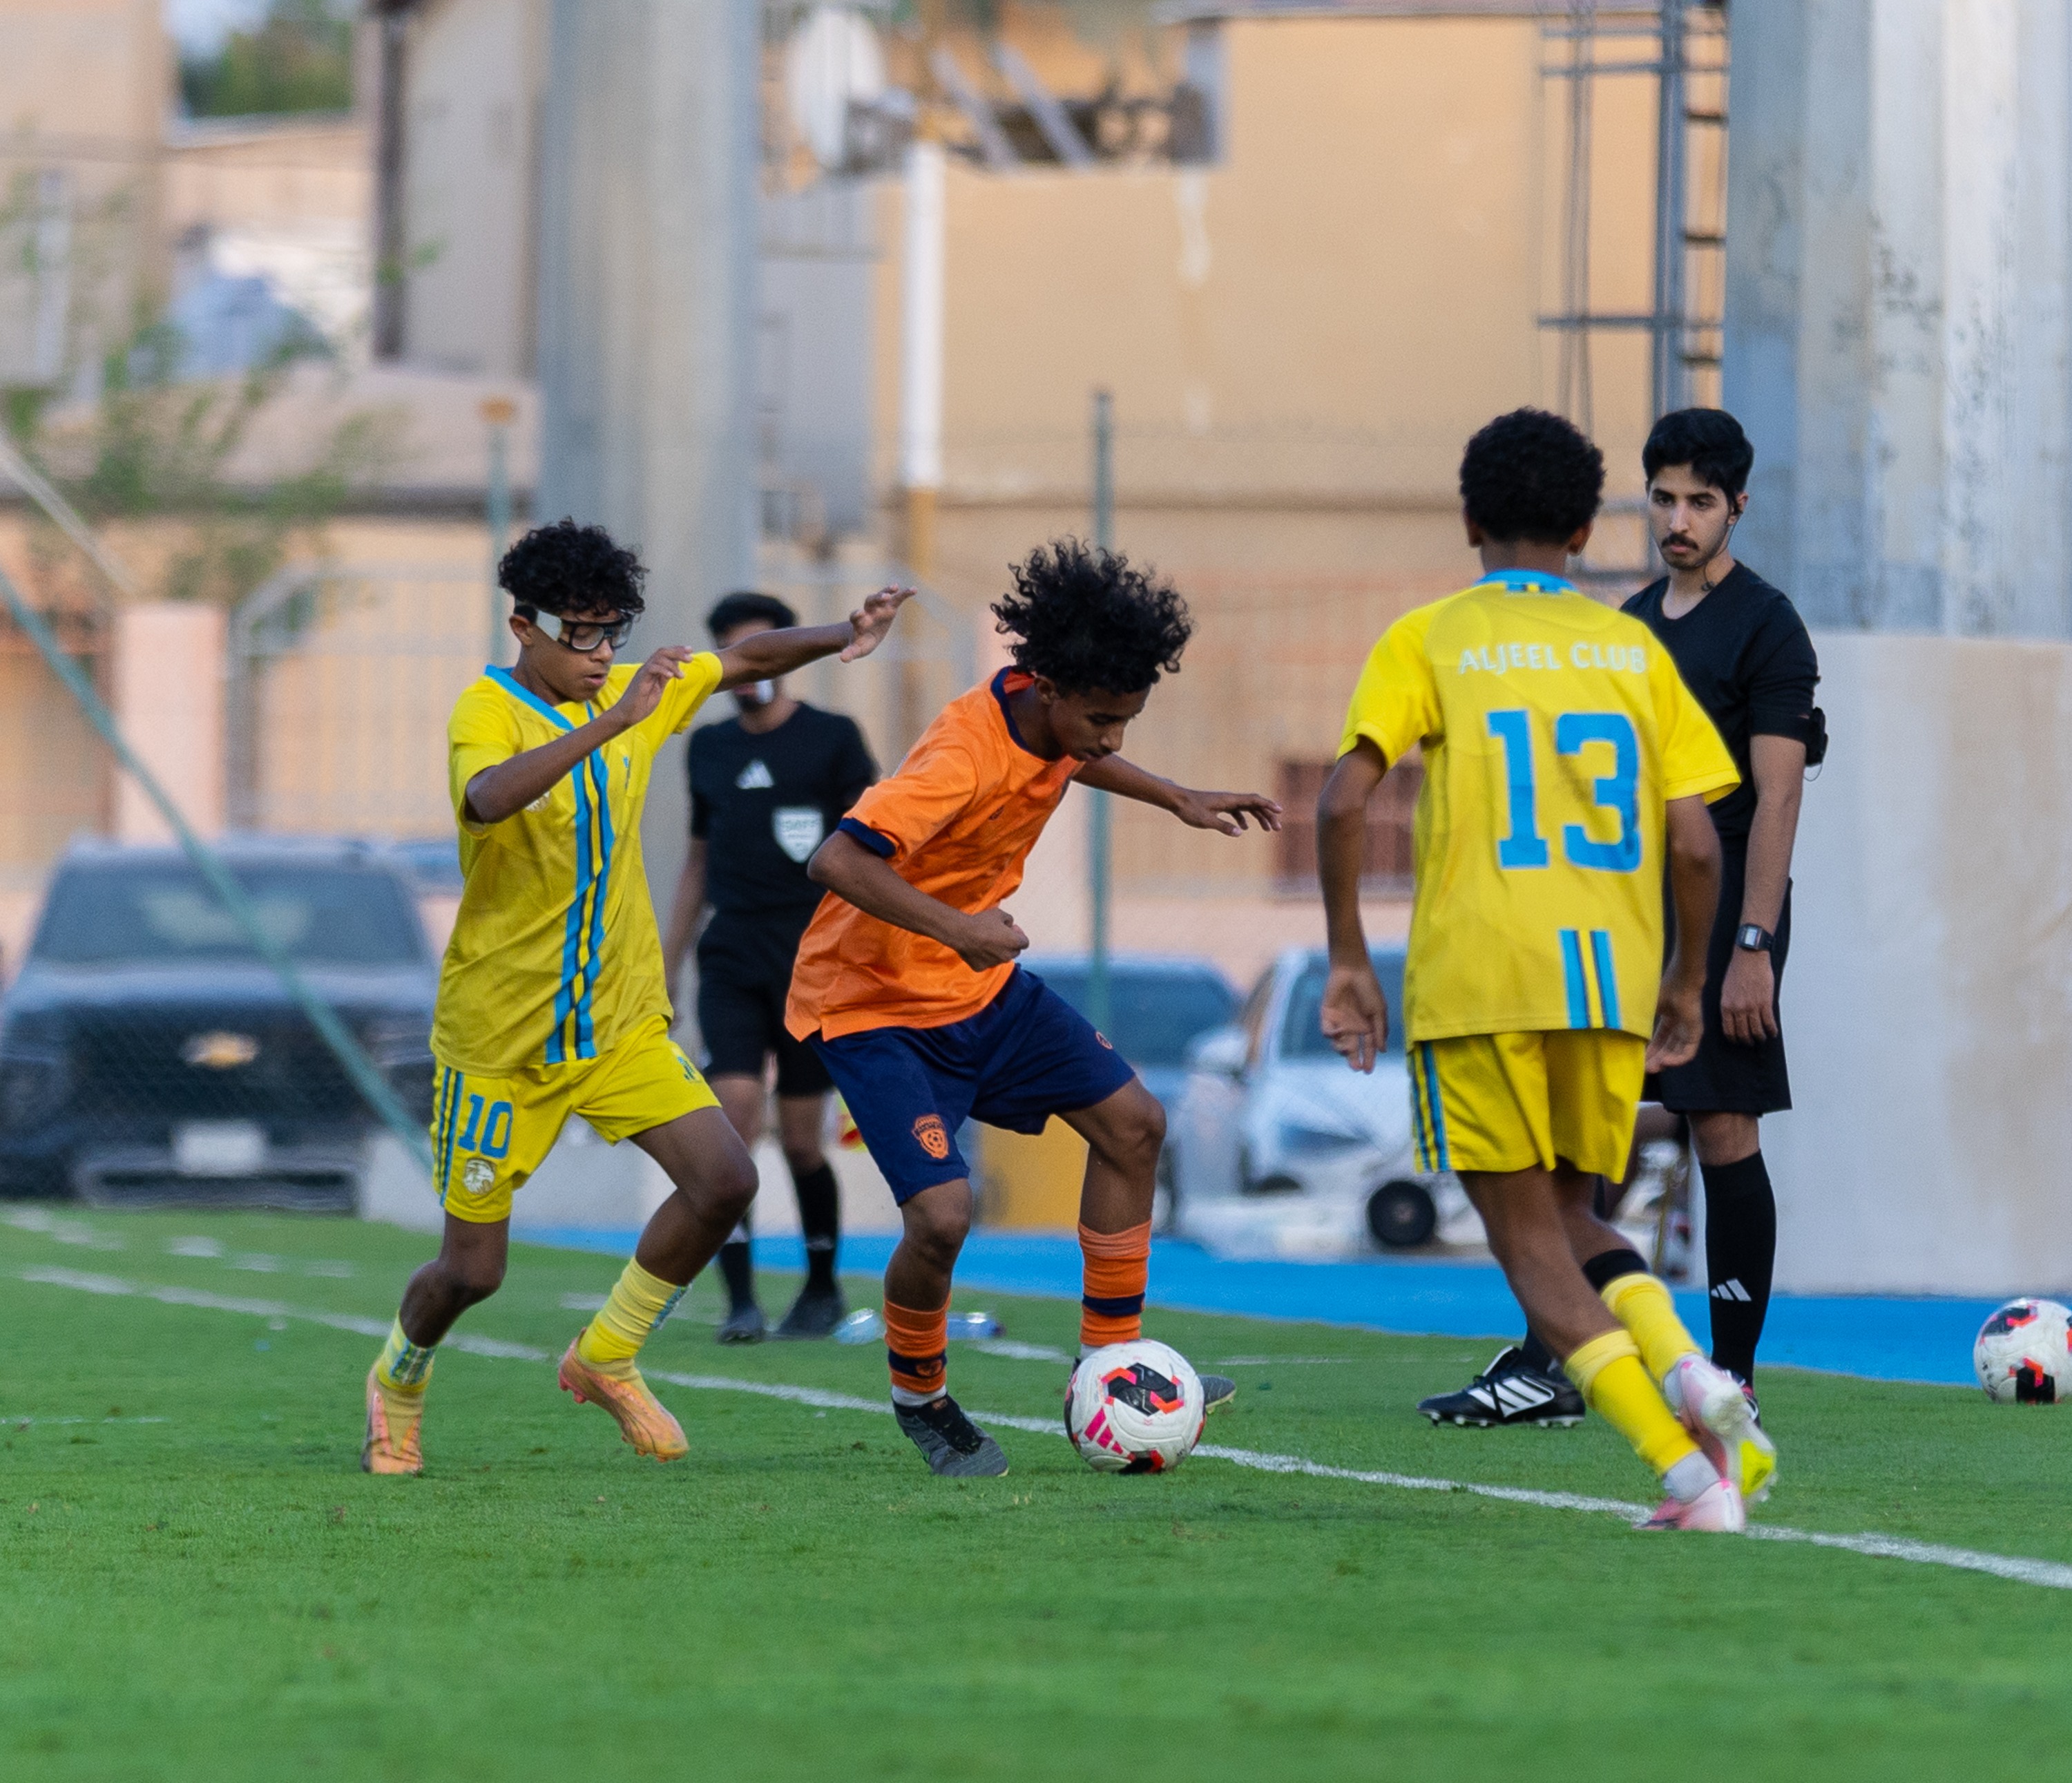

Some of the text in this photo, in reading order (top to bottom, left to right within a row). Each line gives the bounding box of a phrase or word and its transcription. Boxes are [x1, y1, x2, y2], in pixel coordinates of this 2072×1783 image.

[1459, 641, 1646, 675] ALJEEL CLUB
[1486, 709, 1642, 873] 13
[457, 1093, 513, 1159] 10
